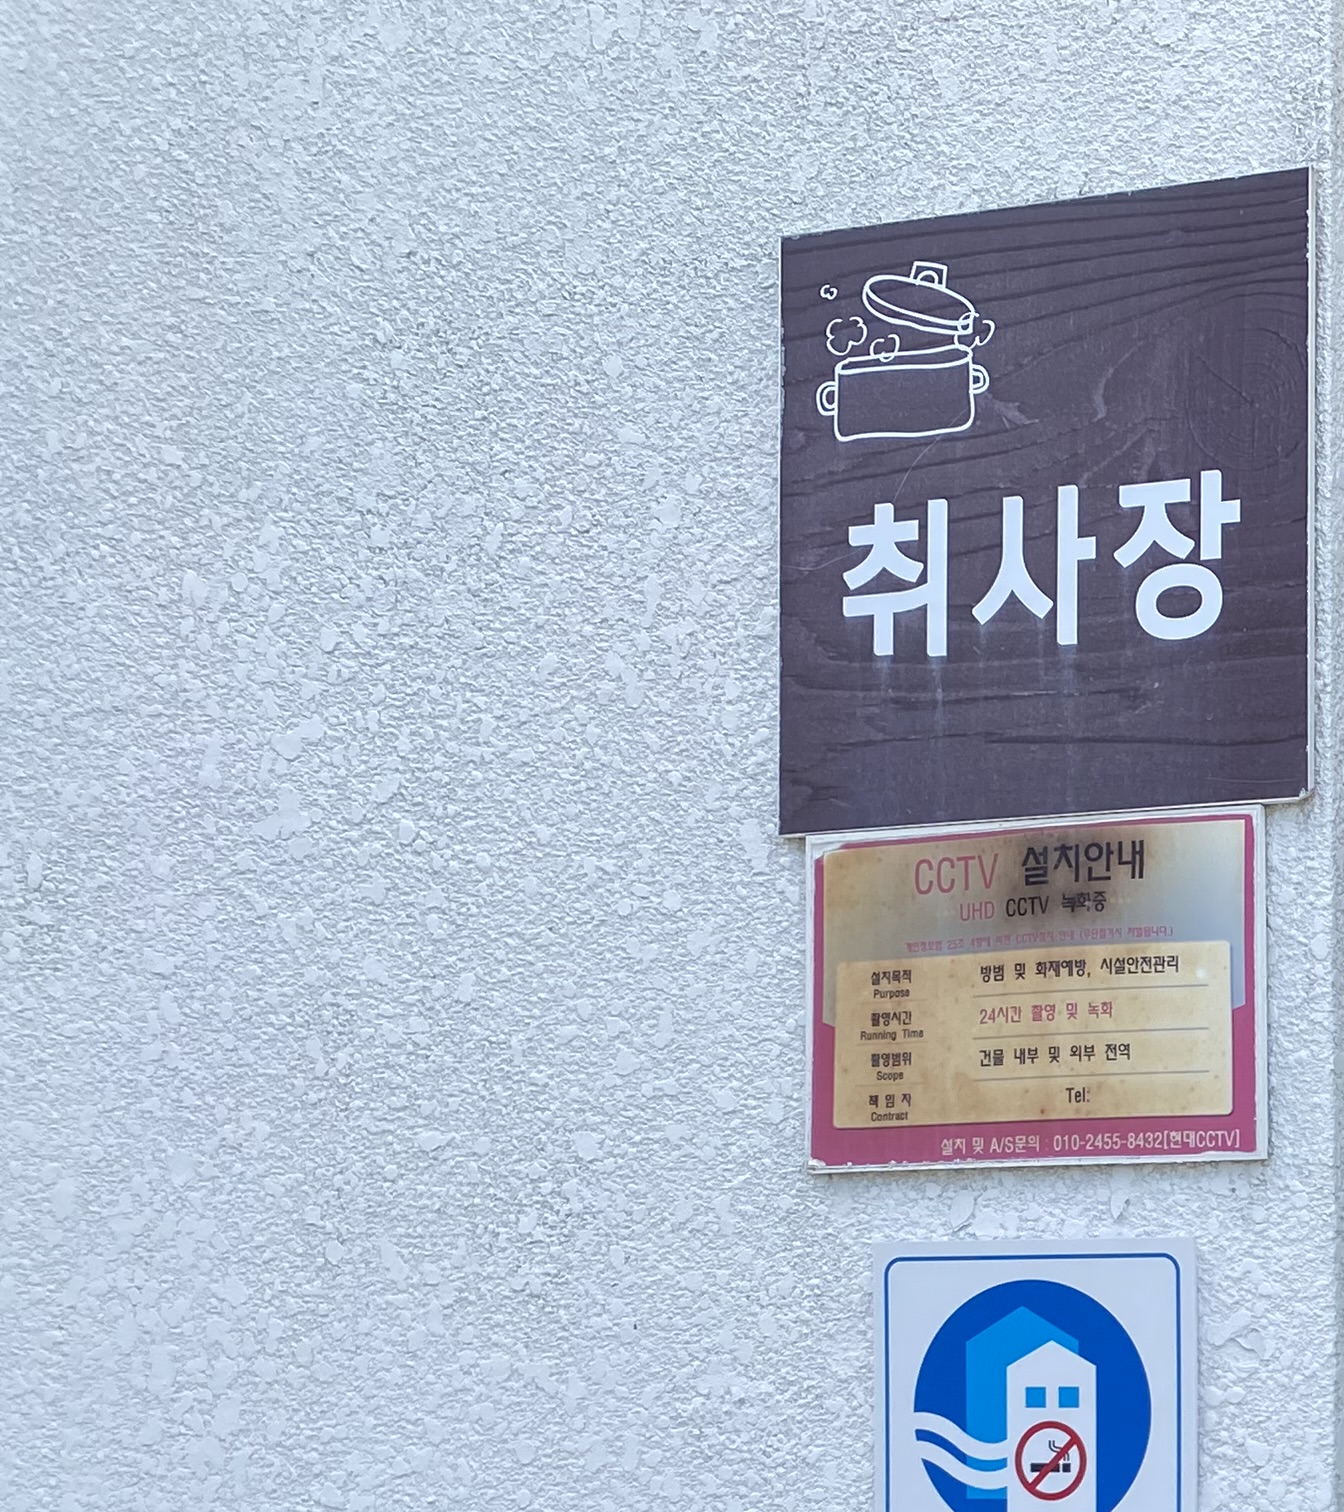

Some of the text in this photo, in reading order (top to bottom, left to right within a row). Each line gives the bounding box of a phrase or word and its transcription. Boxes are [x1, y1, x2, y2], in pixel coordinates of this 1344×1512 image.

[842, 469, 1241, 657] 취사장
[914, 839, 1145, 895] CCTV 설치안내
[960, 891, 1107, 922] UHD CCTV 녹화중
[871, 969, 912, 986] 설치목적
[980, 955, 1180, 983] 방범 및 화재예방, 시설안전관리
[873, 989, 910, 1000] Purpose
[871, 1011, 912, 1027] 촬영시간
[979, 1001, 1114, 1025] 24시간 촬영 및 녹화
[860, 1028, 924, 1041] Running Time
[979, 1043, 1131, 1067] 건물 내부 및 외부 전역
[876, 1071, 904, 1082] Scope
[1065, 1087, 1090, 1104] Tel:
[871, 1111, 908, 1122] Contract
[940, 1137, 966, 1157] 설치
[971, 1136, 984, 1155] 및
[989, 1134, 1040, 1154] A/S문의
